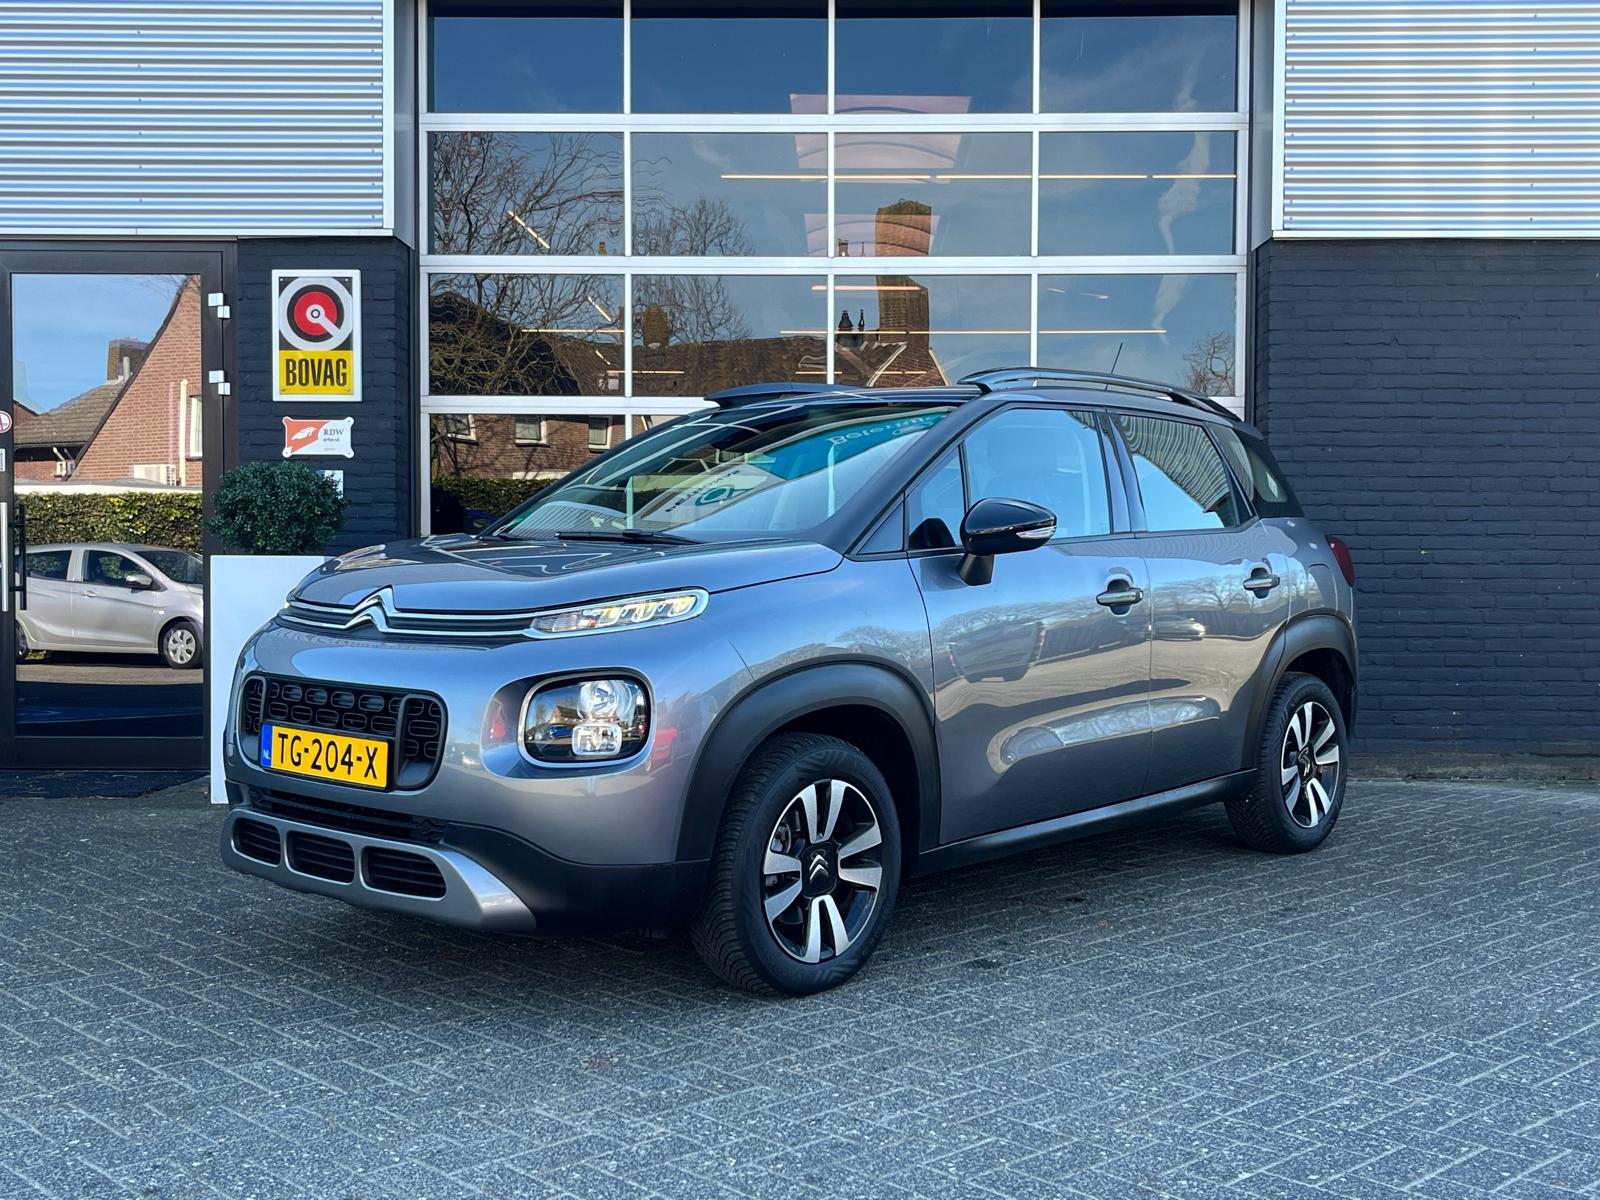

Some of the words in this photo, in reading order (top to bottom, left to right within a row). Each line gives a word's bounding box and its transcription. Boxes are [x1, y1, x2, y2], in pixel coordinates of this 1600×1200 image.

[285, 358, 348, 387] BOVAG
[323, 428, 344, 436] RDW
[278, 733, 378, 779] TG-204-X
